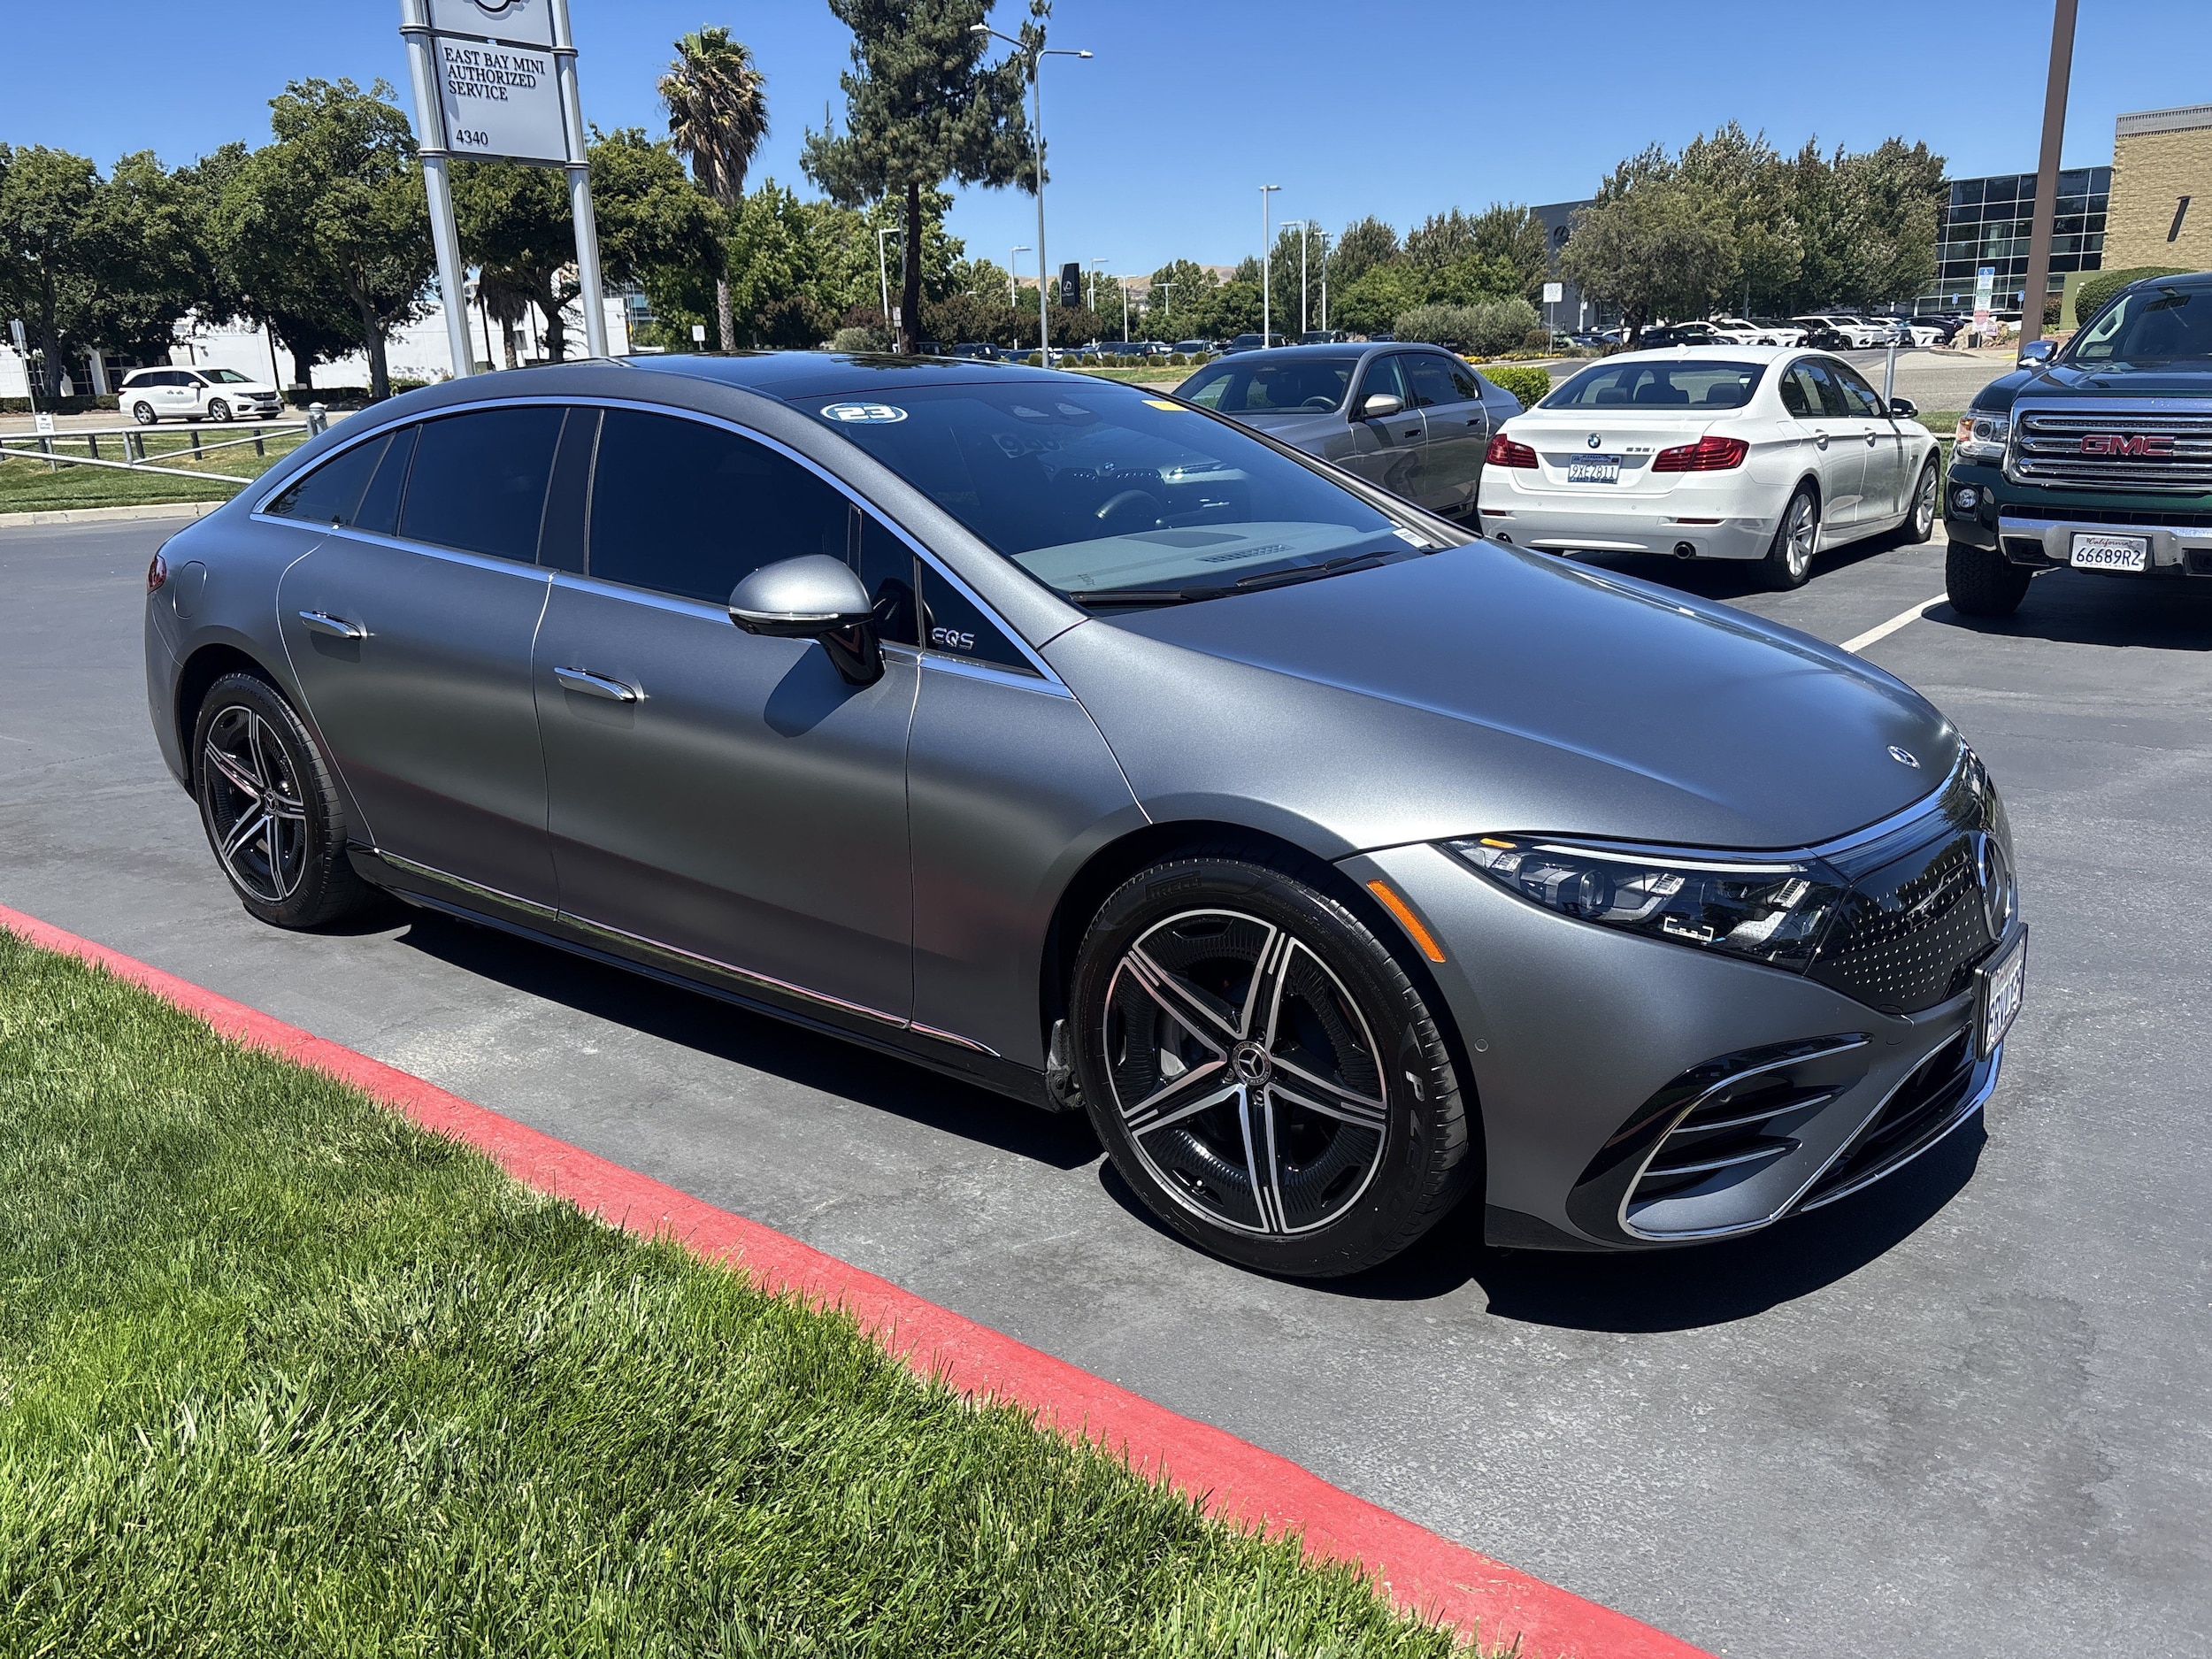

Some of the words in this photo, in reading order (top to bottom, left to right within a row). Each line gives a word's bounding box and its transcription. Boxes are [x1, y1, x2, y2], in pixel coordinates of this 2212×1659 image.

[444, 47, 480, 65] EAST
[484, 52, 509, 70] BAY
[513, 57, 546, 75] MINI
[448, 65, 536, 88] AUTHORIZED
[449, 81, 509, 101] SERVICE
[456, 129, 488, 145] 4340
[834, 405, 897, 420] 23
[2080, 434, 2176, 457] GMC
[2088, 536, 2131, 547] California
[2076, 547, 2142, 567] 66689R2
[932, 627, 975, 650] EQS
[1145, 871, 1202, 900] PIRELLI
